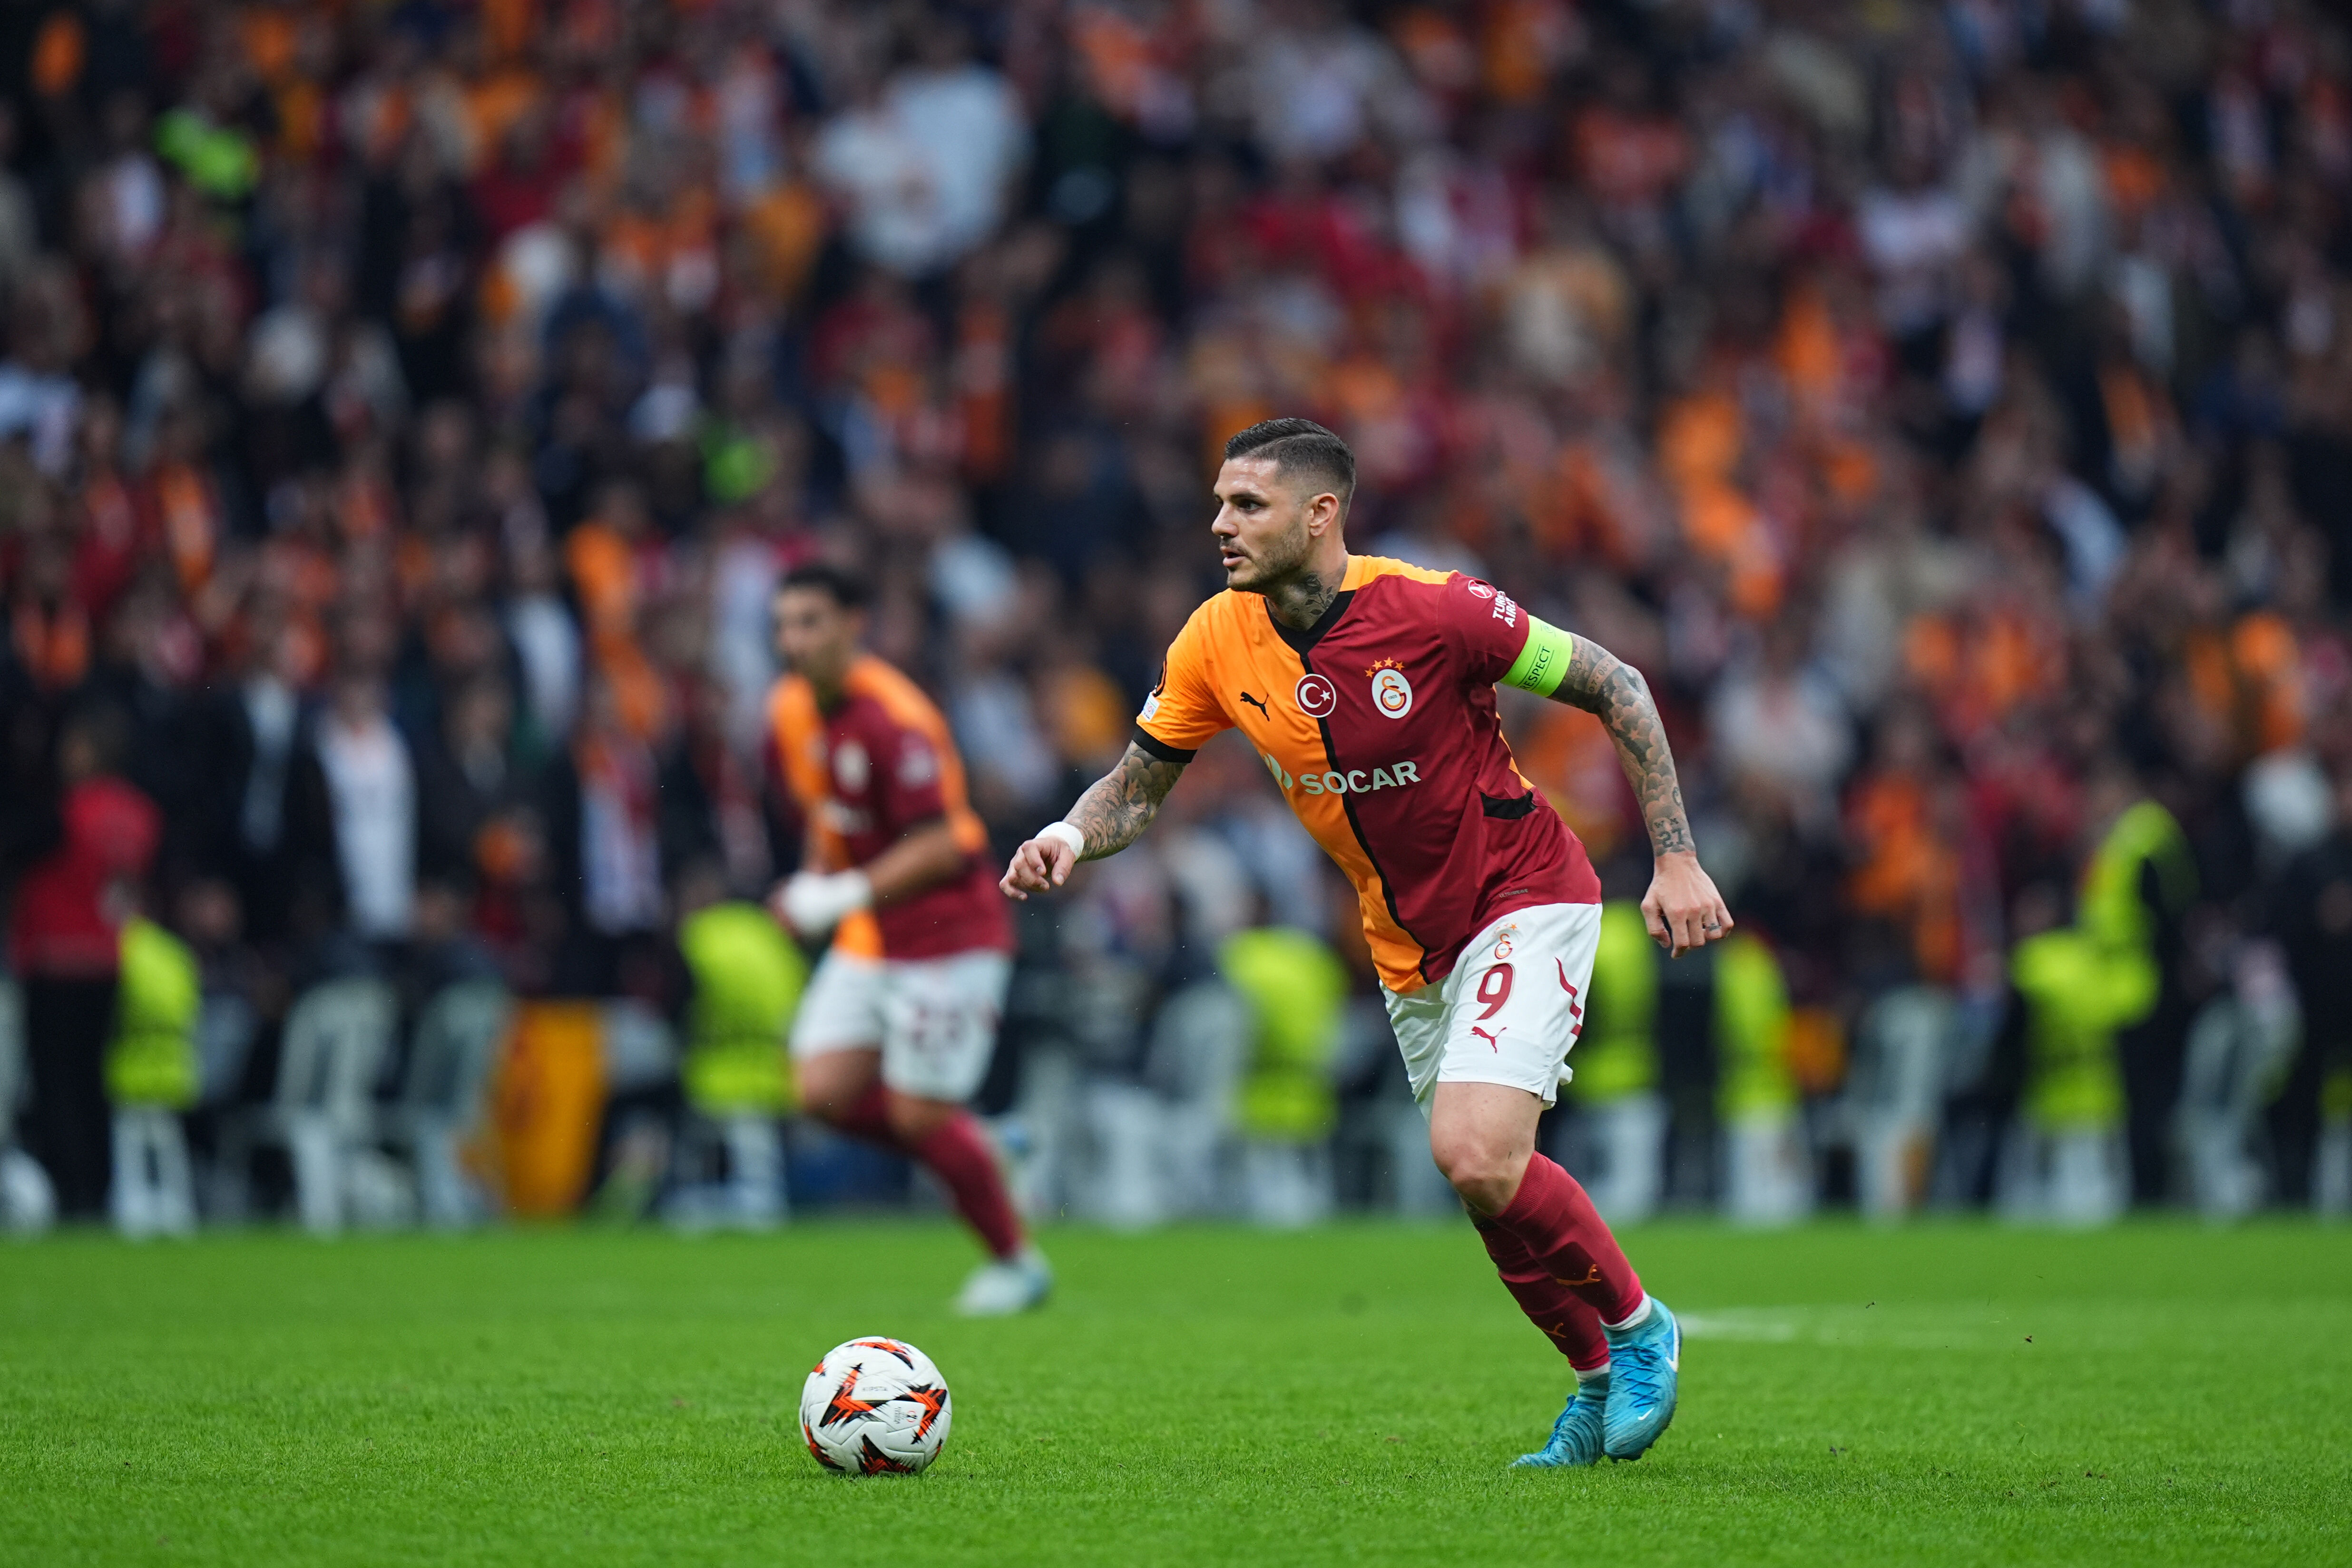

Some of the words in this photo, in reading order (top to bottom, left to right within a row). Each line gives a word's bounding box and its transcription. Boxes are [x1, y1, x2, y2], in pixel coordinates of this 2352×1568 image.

[1519, 646, 1550, 690] RESPECT
[1300, 761, 1421, 794] SOCAR
[1475, 962, 1513, 1020] 9
